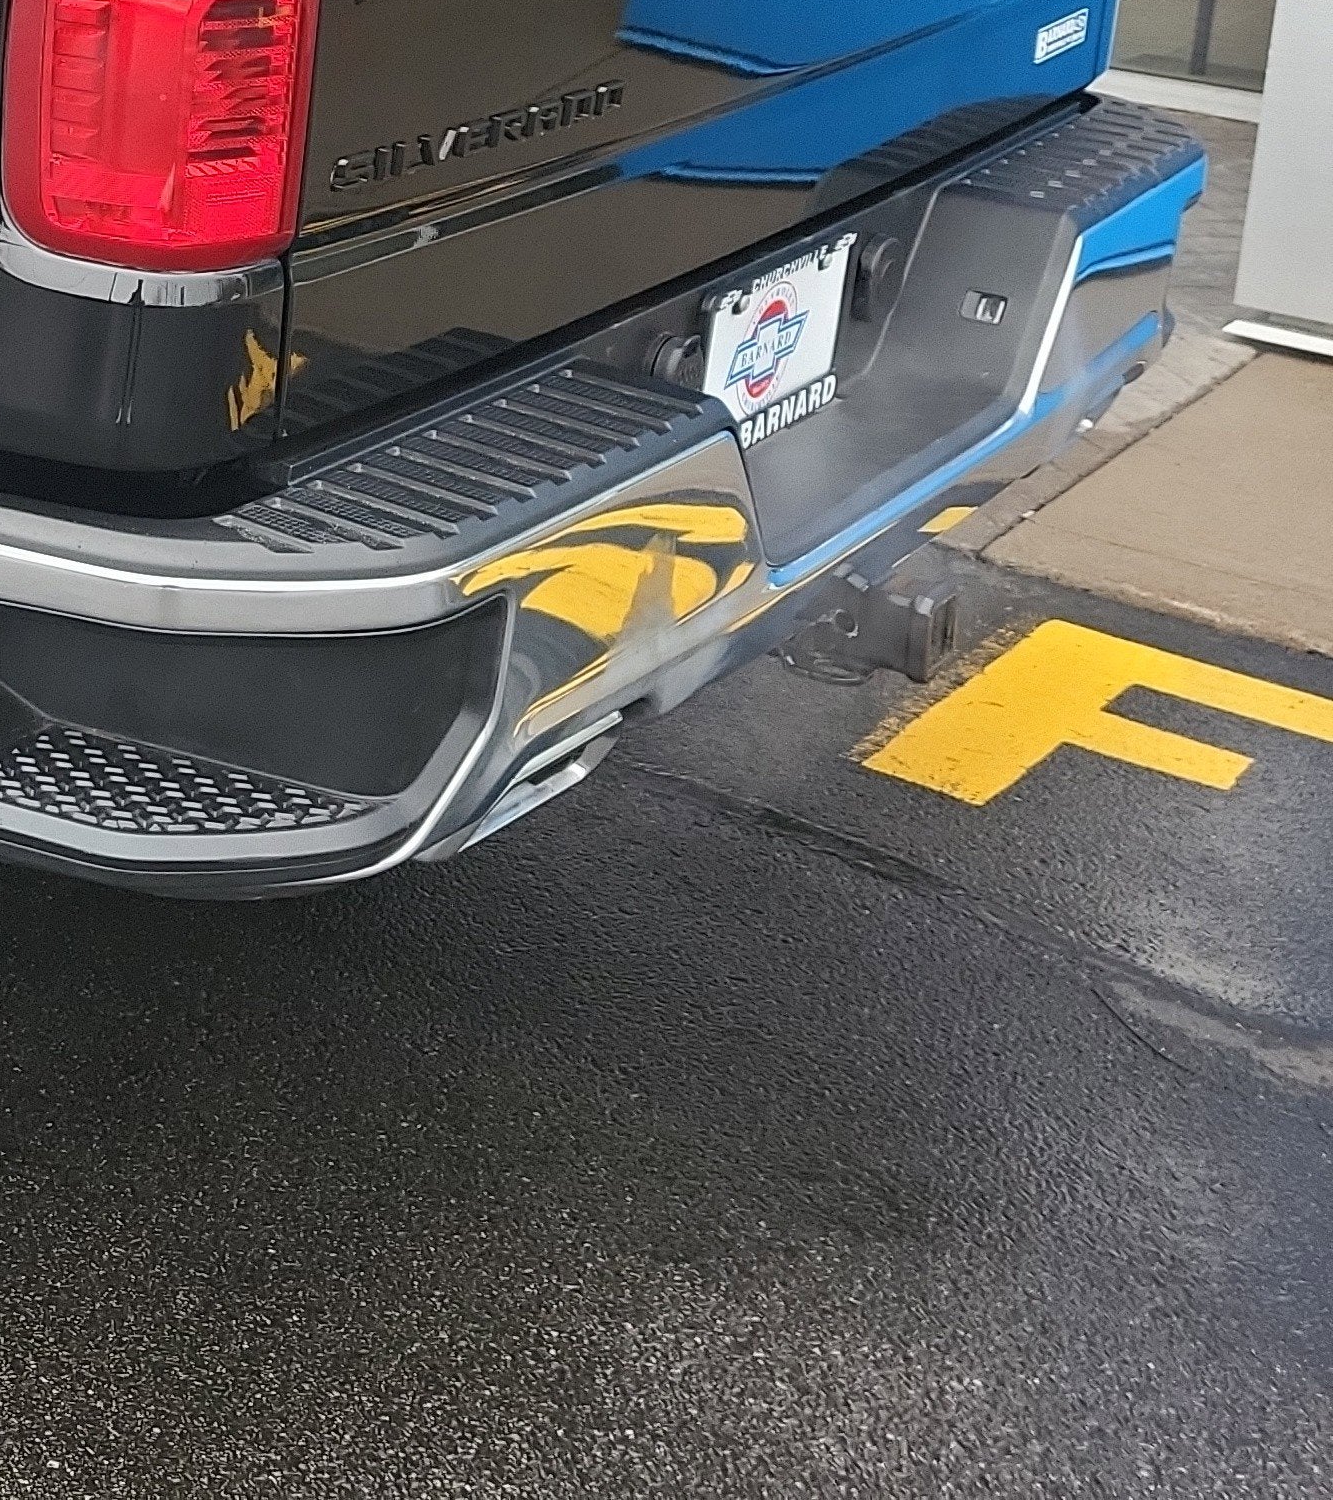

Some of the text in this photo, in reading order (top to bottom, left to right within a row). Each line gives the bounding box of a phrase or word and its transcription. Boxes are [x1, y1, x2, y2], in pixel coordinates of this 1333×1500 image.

[751, 244, 829, 294] CHURCHVILLE
[740, 329, 793, 367] BARNARD
[739, 374, 838, 450] BARNARD
